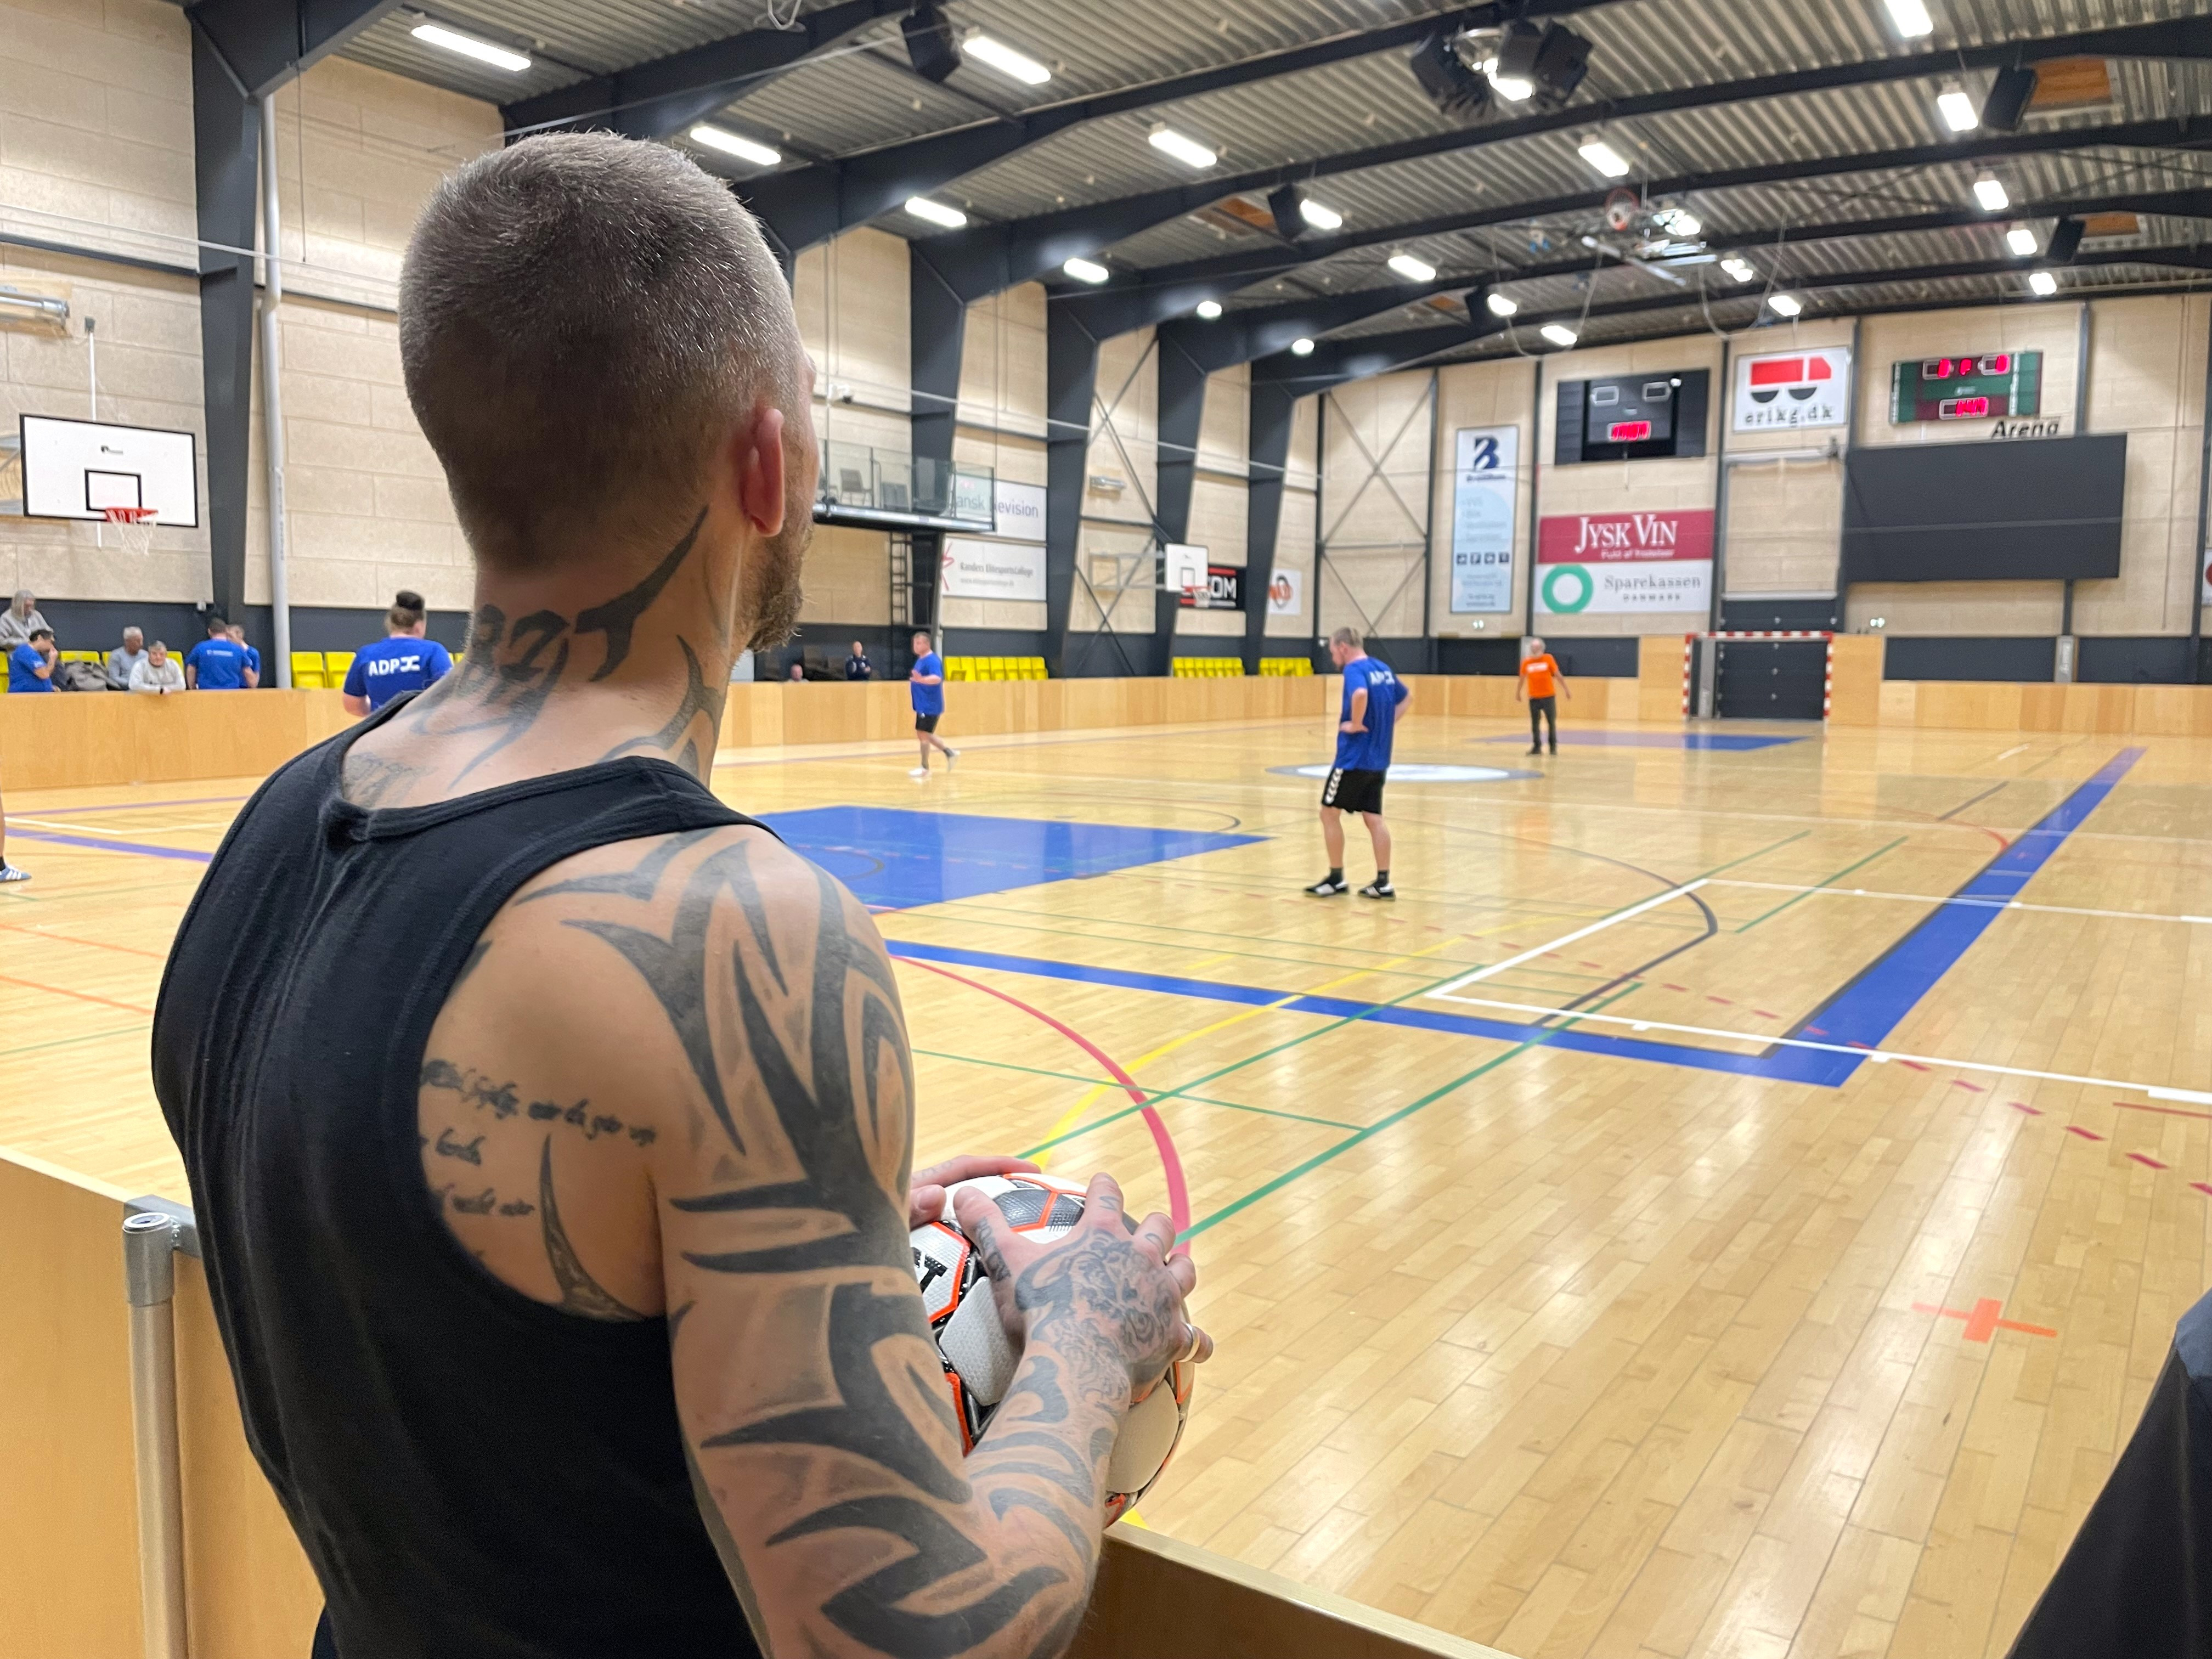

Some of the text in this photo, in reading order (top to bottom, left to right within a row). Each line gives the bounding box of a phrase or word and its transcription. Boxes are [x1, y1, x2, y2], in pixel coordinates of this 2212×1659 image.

[1991, 418, 2059, 438] Arena
[956, 495, 986, 511] ansk
[1604, 573, 1701, 593] Sparekassen
